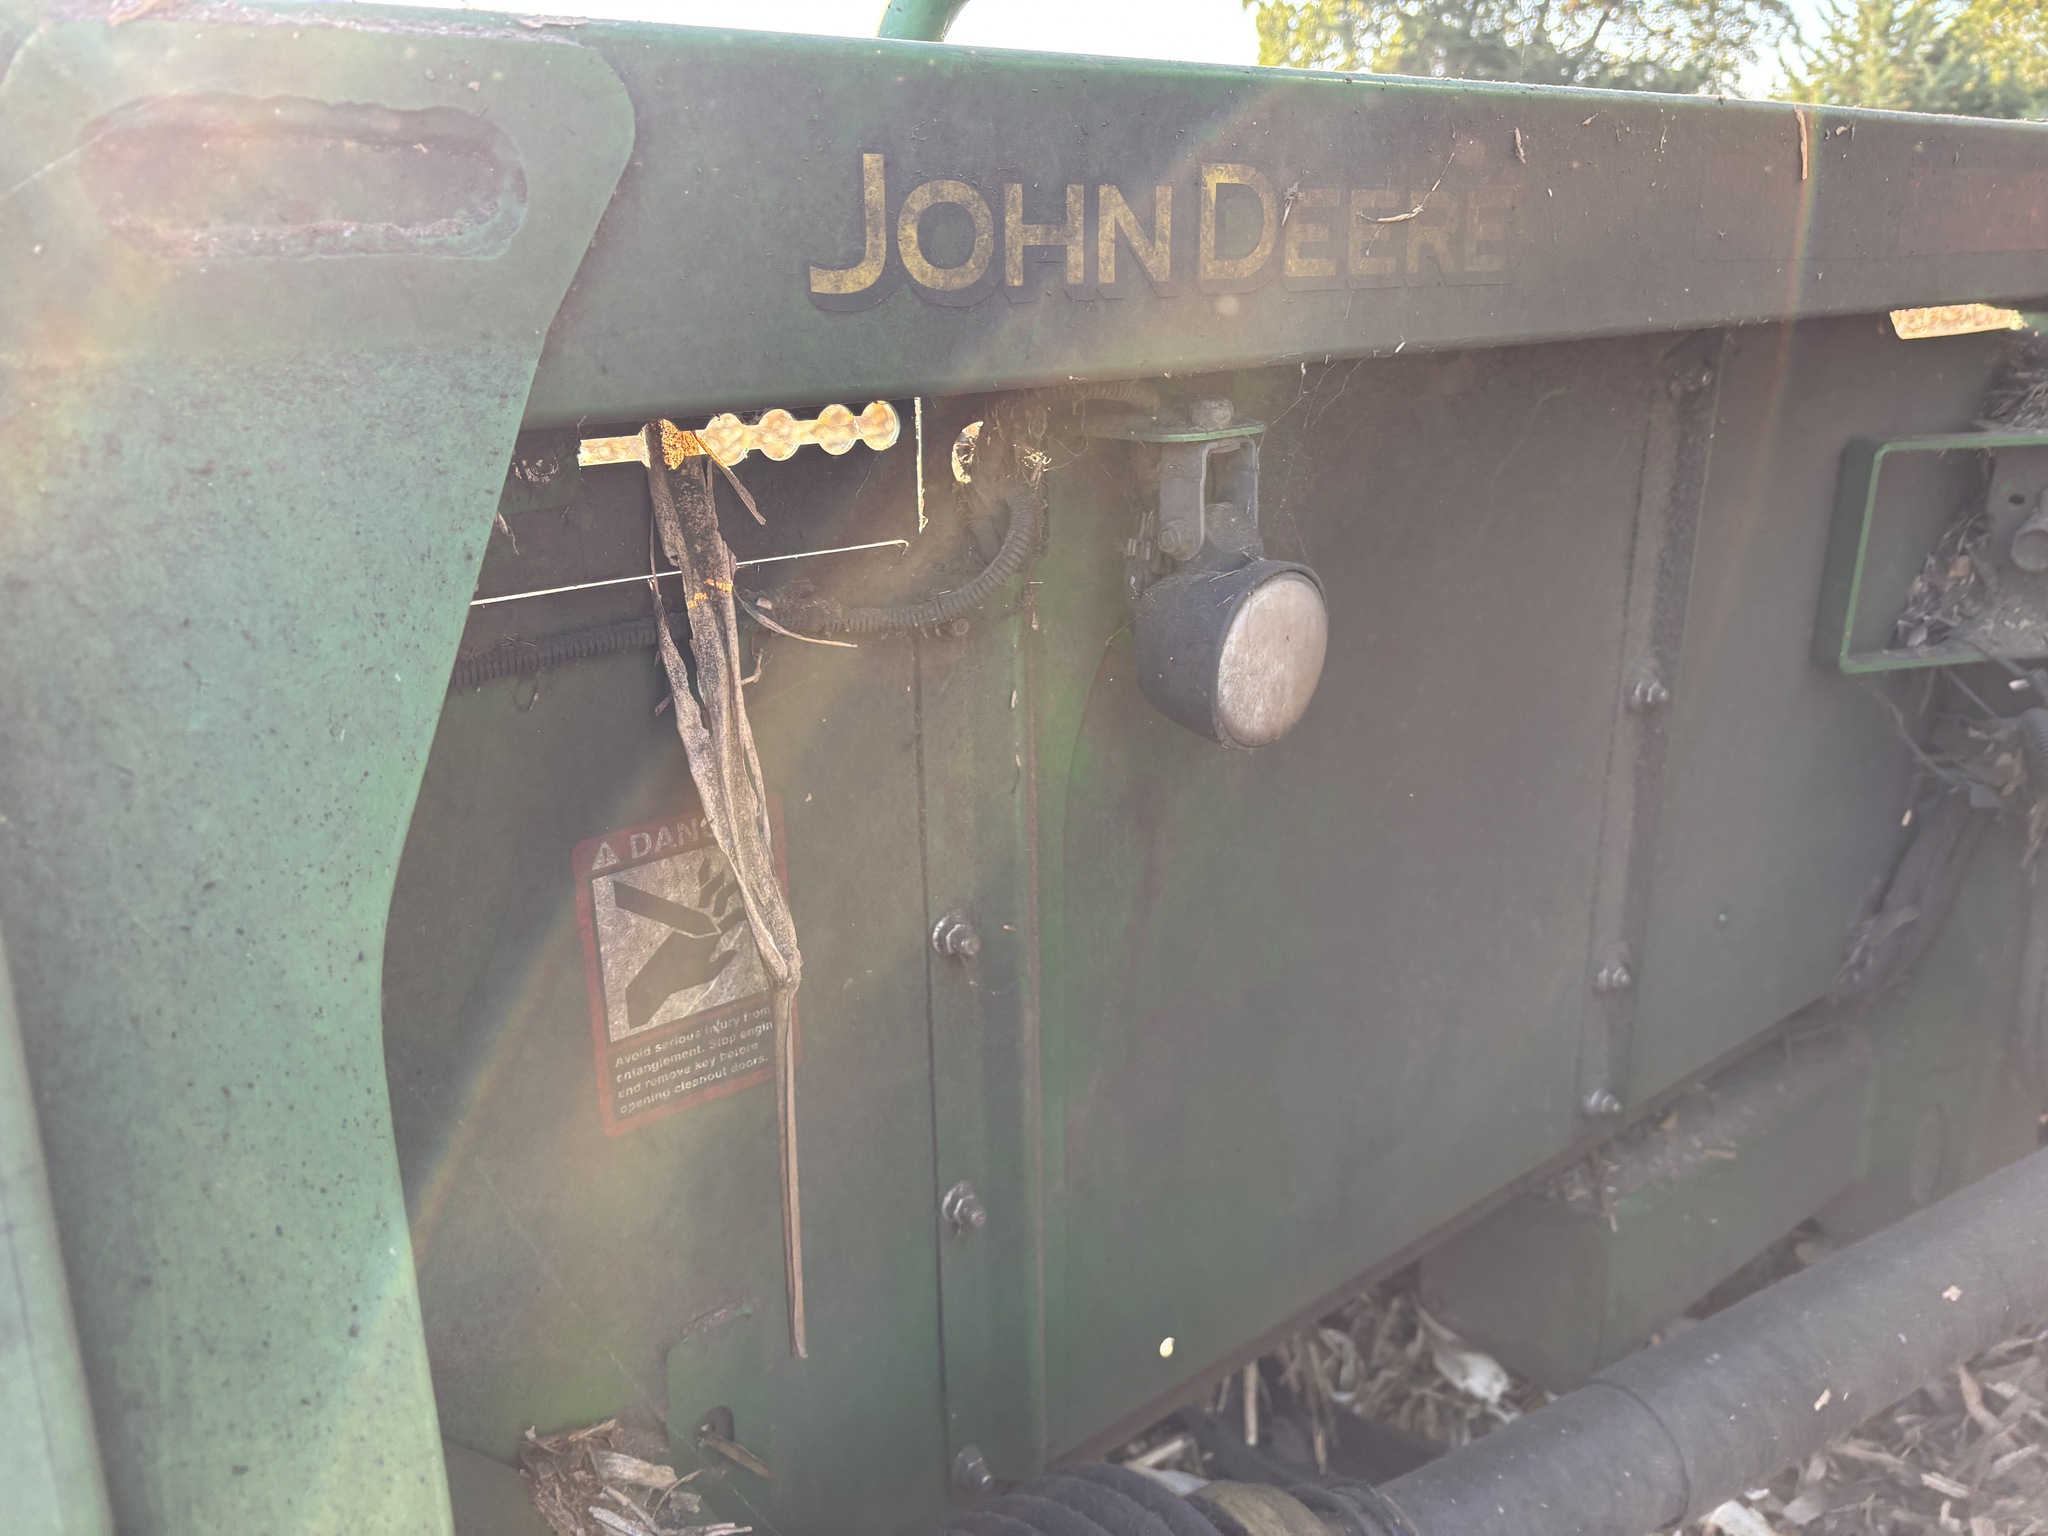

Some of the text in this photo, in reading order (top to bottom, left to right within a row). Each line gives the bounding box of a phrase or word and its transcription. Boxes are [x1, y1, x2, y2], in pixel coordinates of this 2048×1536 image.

[809, 152, 1512, 294] JOHN DEERE
[614, 1006, 771, 1068] Avoid serious injury from
[616, 1020, 773, 1083] entanglement. Stop engin
[618, 1041, 758, 1099] and remove key before
[620, 1054, 769, 1114] opening cleanout doors.
